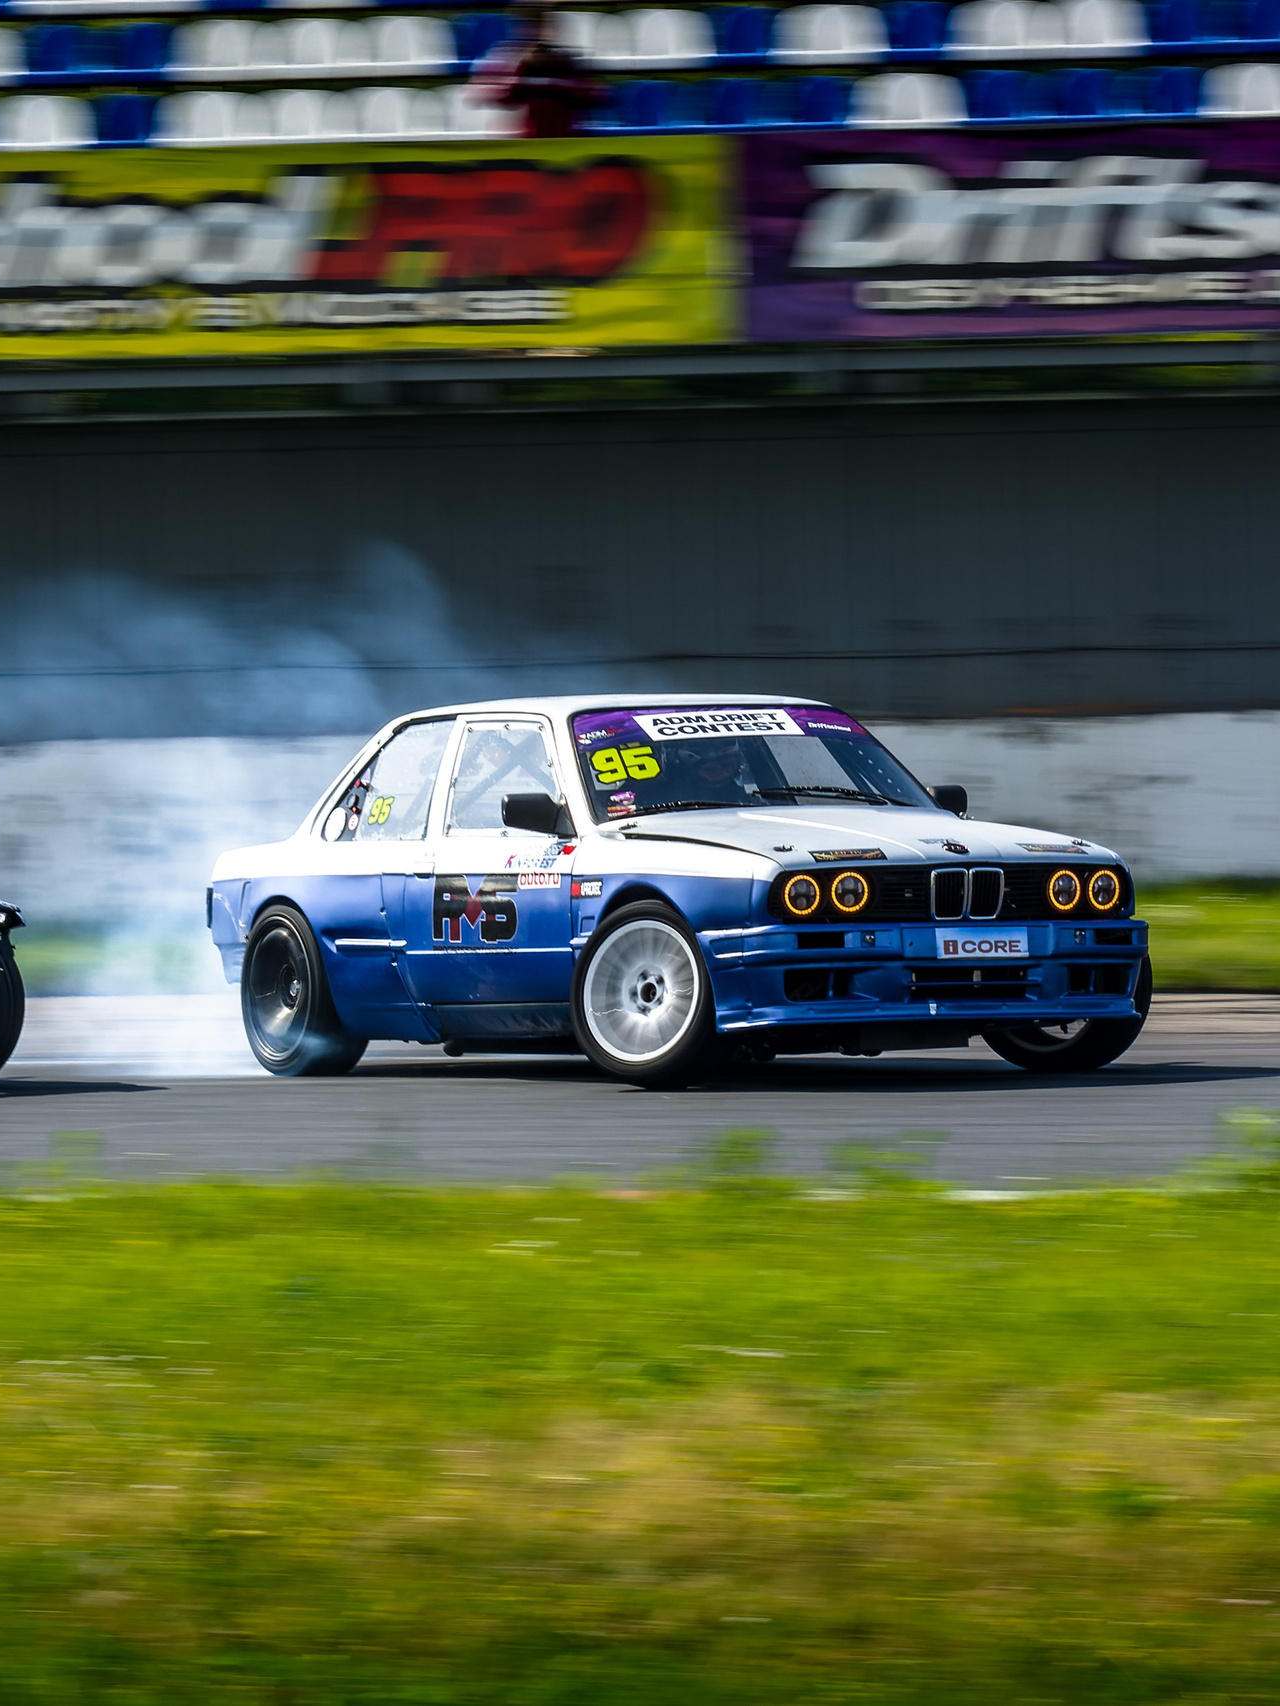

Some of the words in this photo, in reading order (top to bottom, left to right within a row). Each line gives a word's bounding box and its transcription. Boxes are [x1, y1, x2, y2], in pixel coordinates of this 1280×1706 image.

[652, 715, 707, 727] ADM
[712, 712, 777, 722] DRIFT
[658, 722, 785, 736] CONTEST
[591, 746, 661, 784] 95
[367, 796, 395, 825] 95
[519, 871, 560, 886] auto.ru
[961, 940, 1021, 953] CORE
